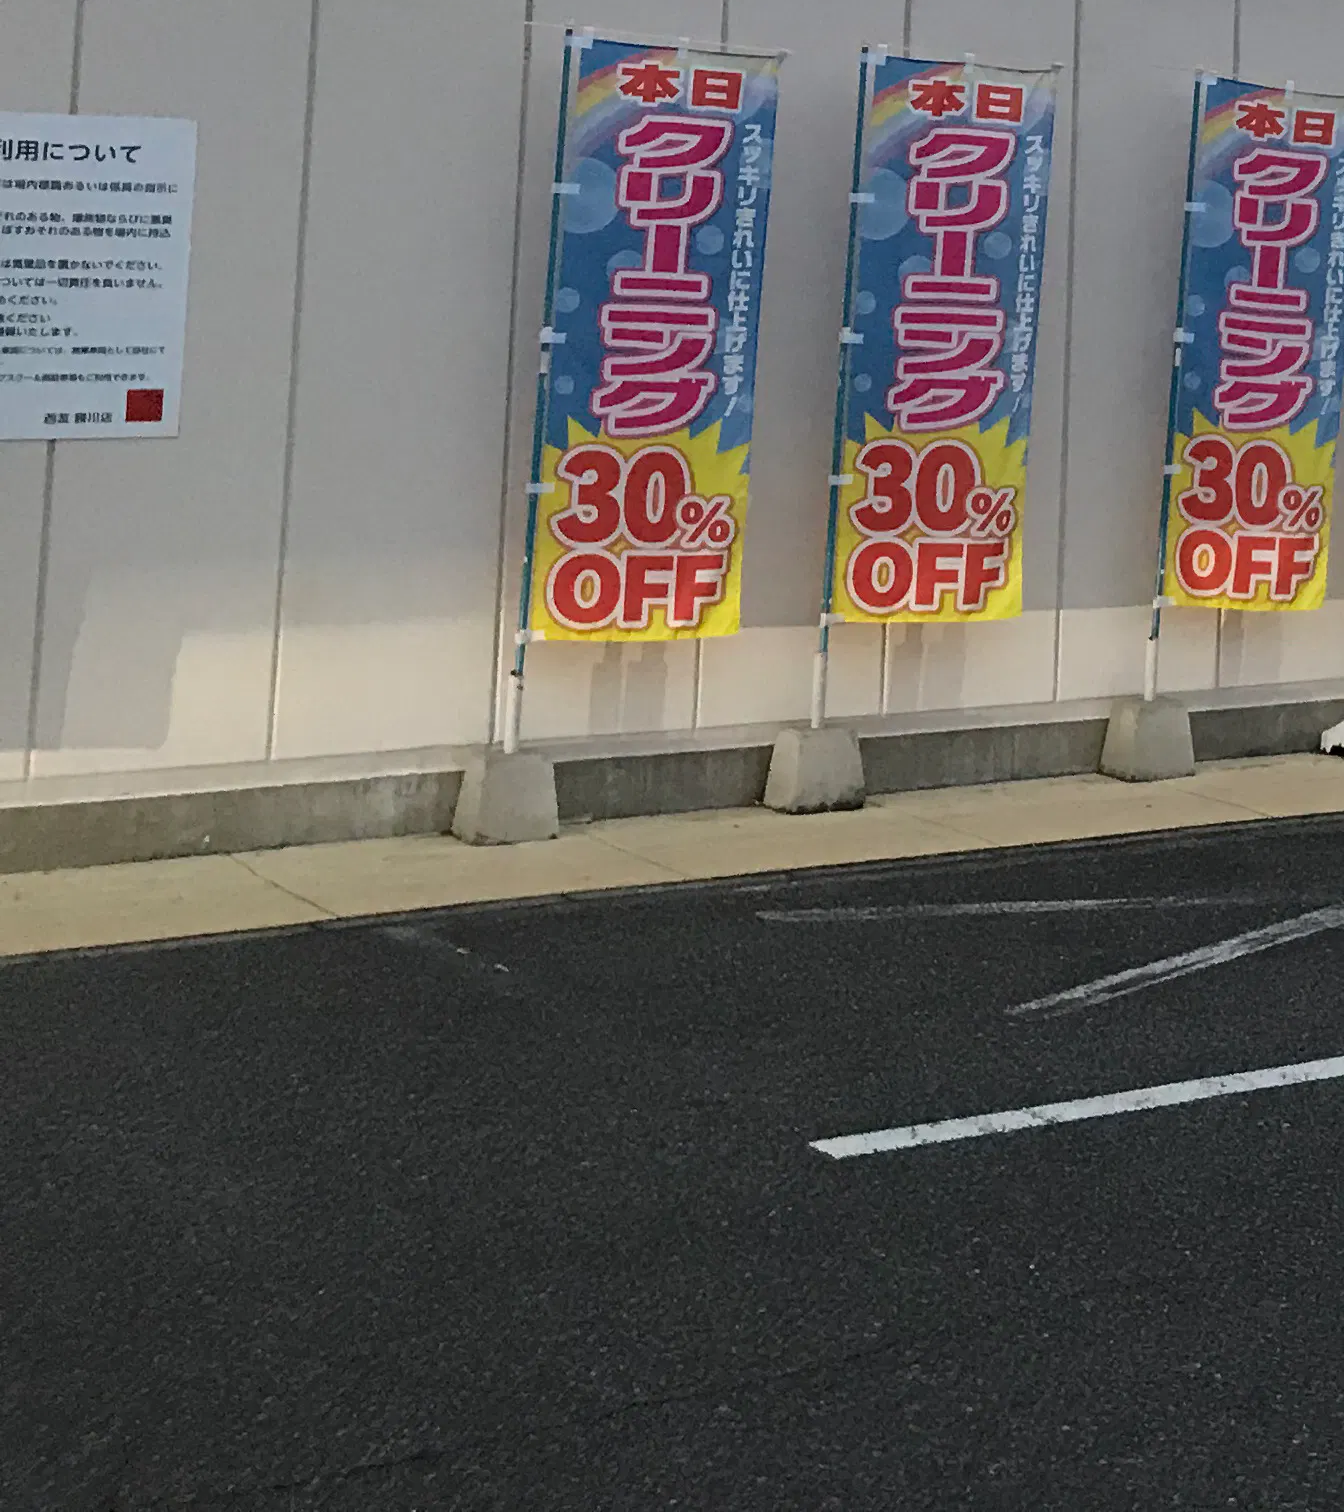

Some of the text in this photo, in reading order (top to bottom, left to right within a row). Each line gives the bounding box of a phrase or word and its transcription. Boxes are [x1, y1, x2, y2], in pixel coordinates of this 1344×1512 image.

[619, 62, 743, 110] 本日
[910, 79, 1025, 123] 本日
[1235, 102, 1336, 146] 本日
[593, 115, 732, 437] クリーニング
[888, 128, 1016, 432] クリーニング
[1213, 148, 1327, 431] クリーニング
[551, 444, 733, 547] 30%
[853, 439, 1016, 539] 30%
[1178, 434, 1323, 531] 30%
[548, 551, 727, 629] OFF
[849, 538, 1008, 612] OFF
[1174, 528, 1319, 601] OFF
